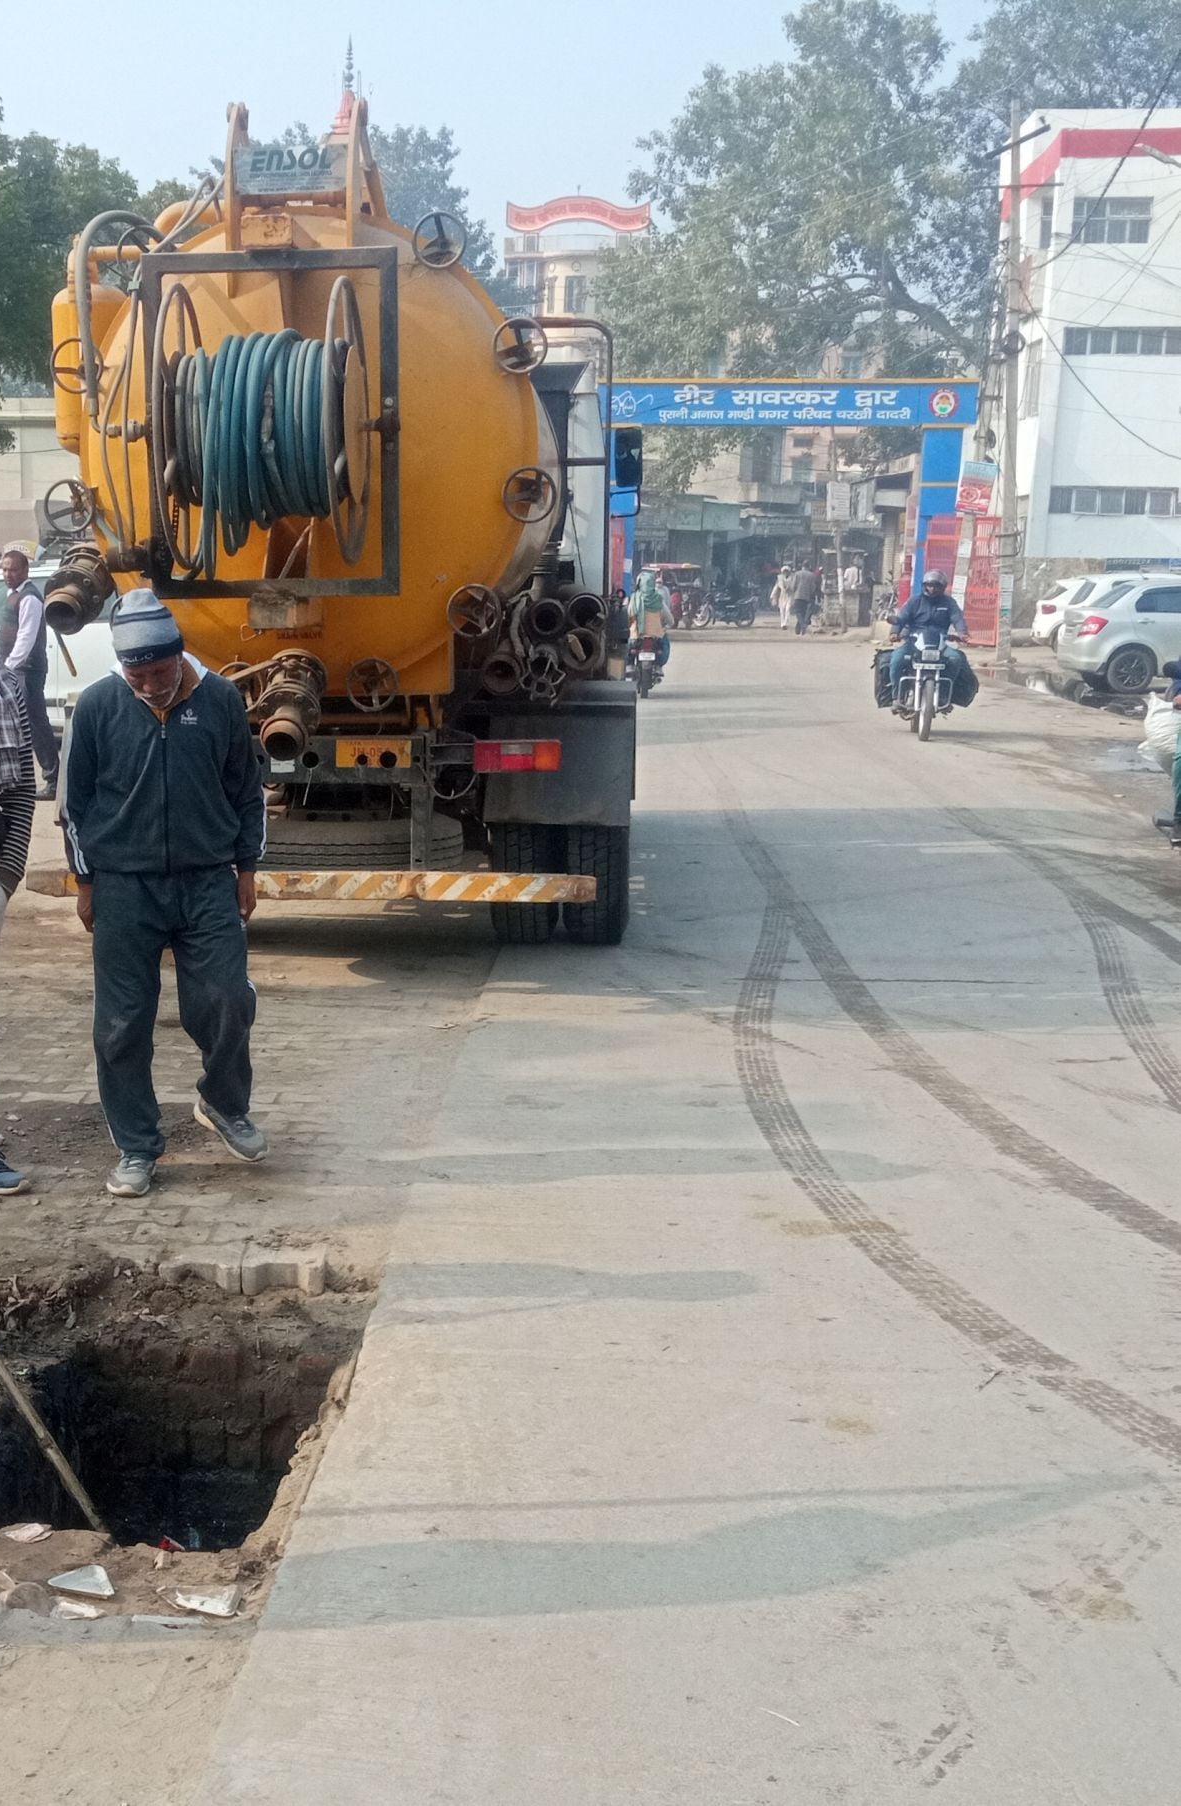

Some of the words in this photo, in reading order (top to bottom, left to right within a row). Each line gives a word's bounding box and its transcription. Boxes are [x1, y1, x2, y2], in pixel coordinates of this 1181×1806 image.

[673, 384, 715, 405] वीर
[731, 389, 839, 405] सावरकर
[854, 389, 899, 407] द्वार
[659, 407, 688, 423] पुरानी
[690, 409, 724, 420] अनाज
[758, 410, 789, 420] नगर
[876, 407, 912, 420] दादरी
